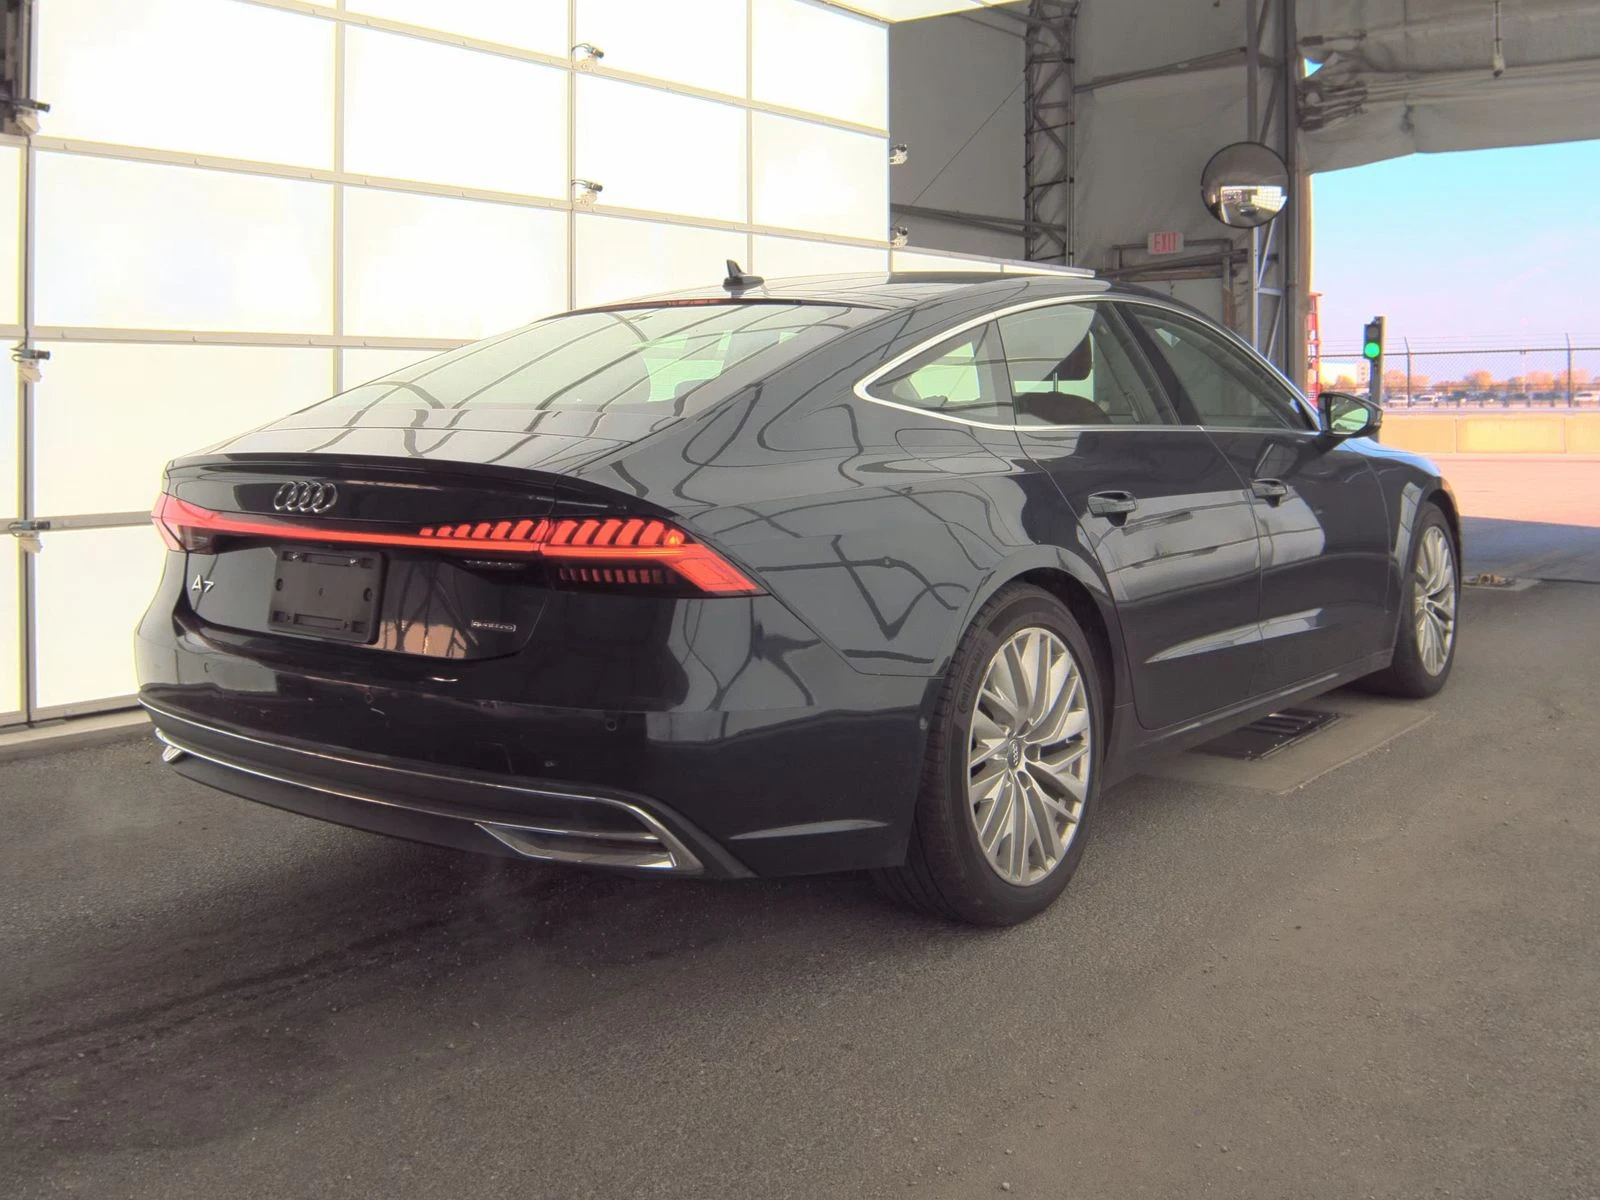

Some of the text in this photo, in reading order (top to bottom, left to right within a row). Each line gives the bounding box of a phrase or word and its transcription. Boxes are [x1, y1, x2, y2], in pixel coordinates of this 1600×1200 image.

[1154, 232, 1180, 251] EXIT
[191, 573, 215, 593] A7
[957, 643, 988, 714] Contin
